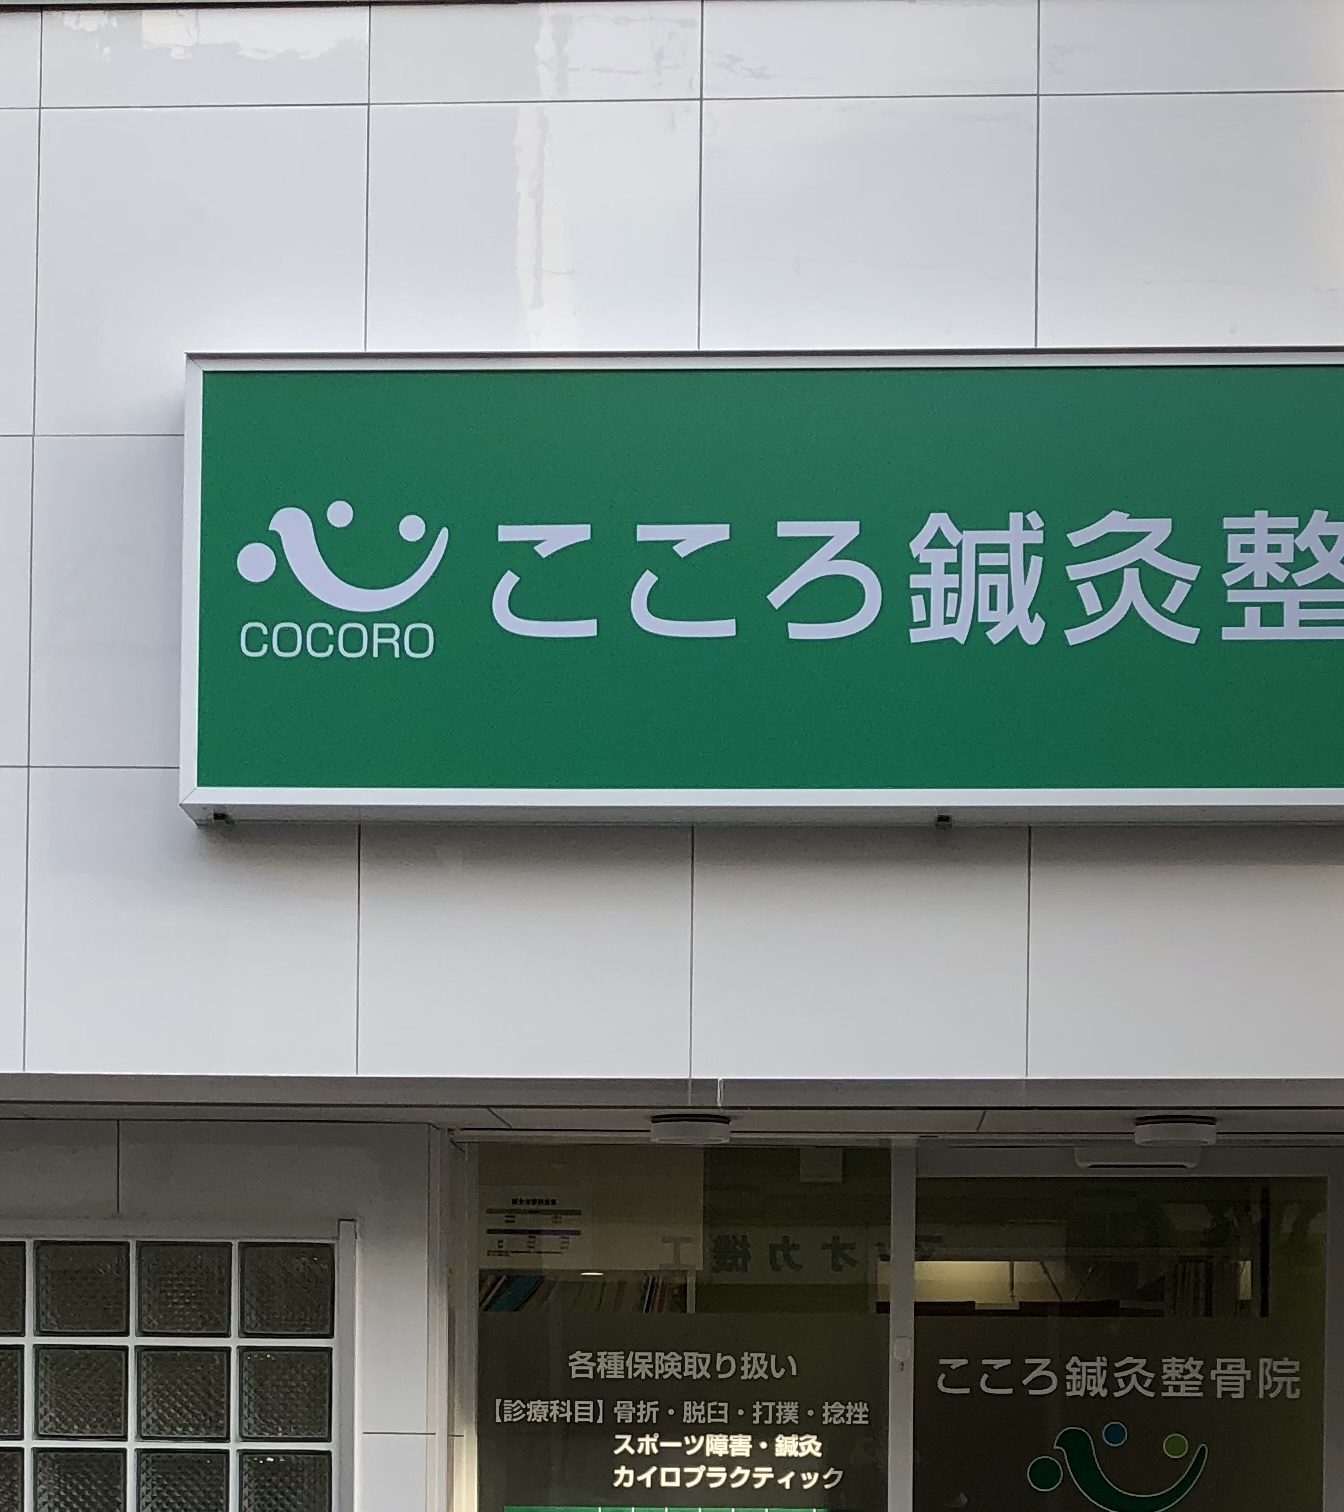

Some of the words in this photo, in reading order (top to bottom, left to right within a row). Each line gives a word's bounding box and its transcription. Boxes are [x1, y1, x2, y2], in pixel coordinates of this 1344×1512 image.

[239, 621, 435, 659] COCORO
[568, 1350, 797, 1380] 各種保険取り扱い
[937, 1355, 1301, 1399] こころ鍼灸整骨院
[613, 1465, 843, 1490] カイロプラクティック
